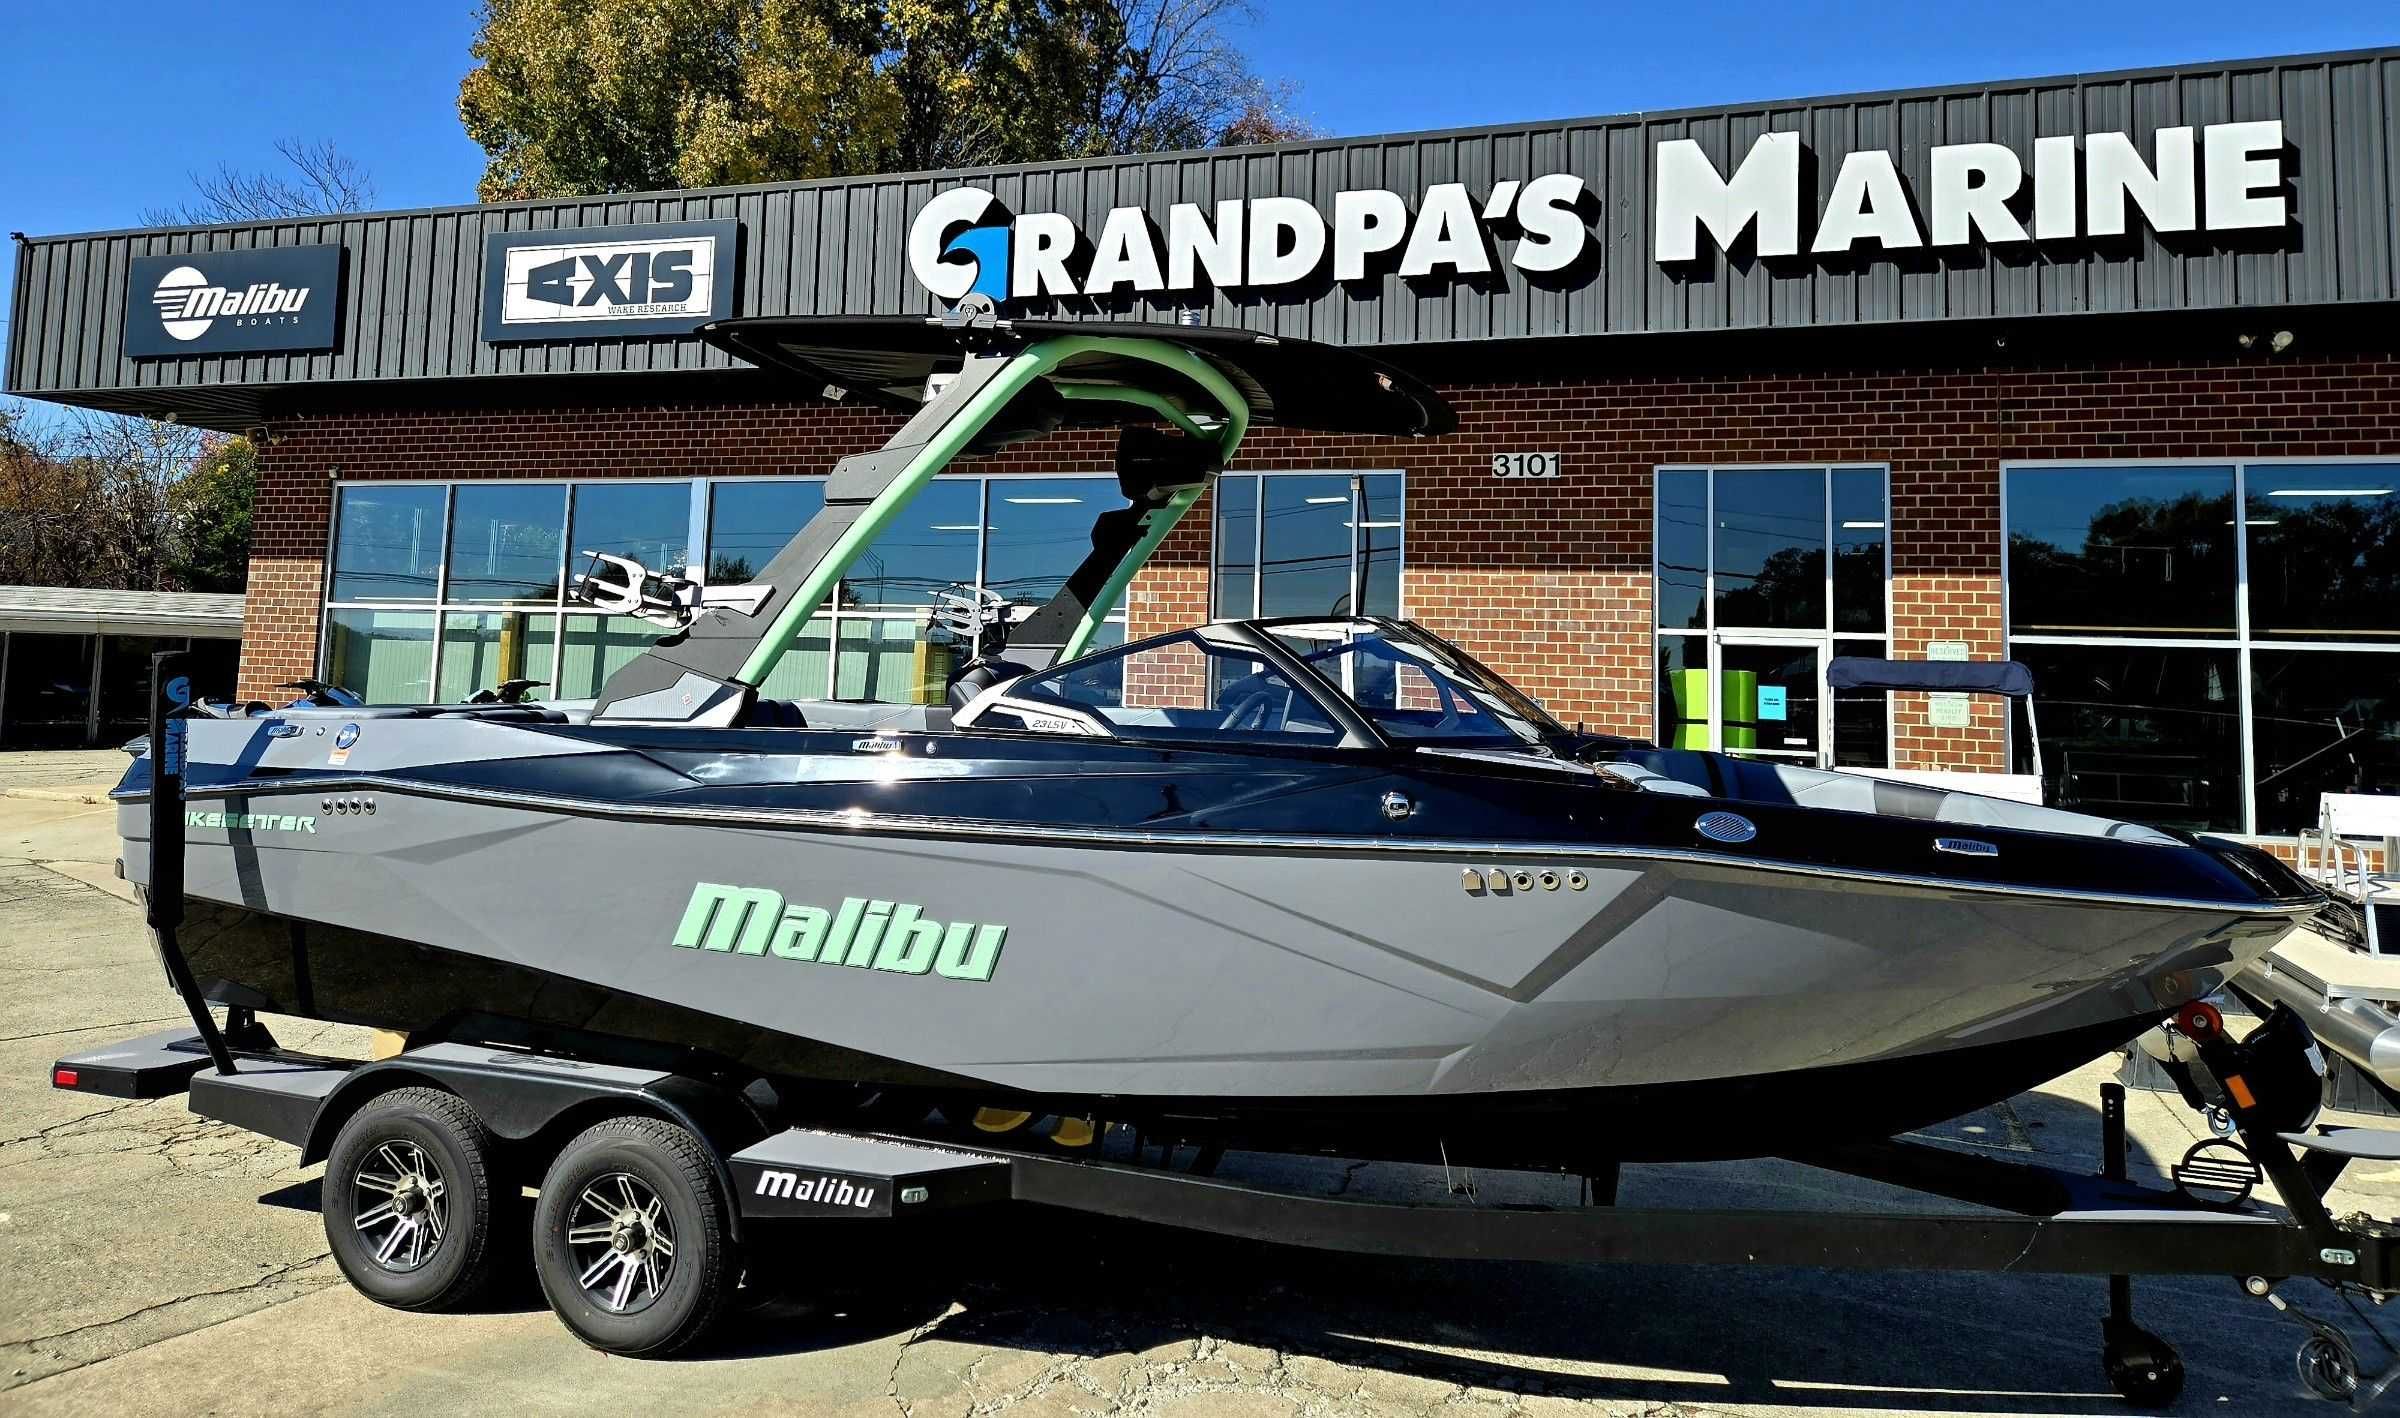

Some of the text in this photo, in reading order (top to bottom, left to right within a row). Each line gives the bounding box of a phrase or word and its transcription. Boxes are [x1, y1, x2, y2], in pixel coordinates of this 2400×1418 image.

[908, 119, 2287, 303] GRANDPA'S MARINE
[526, 249, 693, 307] AXIS
[181, 282, 310, 318] Malibu
[607, 303, 687, 314] WAKE RESEARCH
[236, 317, 299, 327] BOATS
[1493, 453, 1560, 477] 3101
[185, 811, 316, 834] KESETTER
[672, 882, 1008, 982] Malibu
[755, 1170, 875, 1209] Malibu
